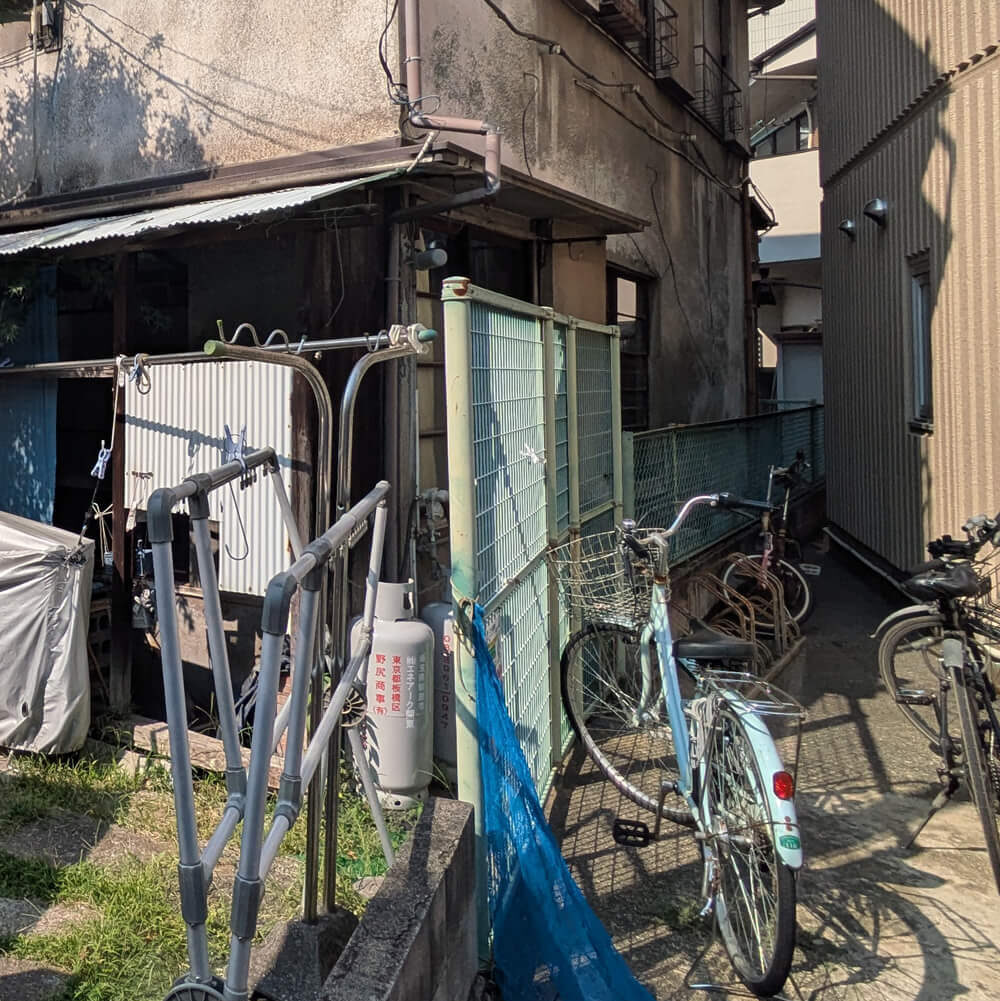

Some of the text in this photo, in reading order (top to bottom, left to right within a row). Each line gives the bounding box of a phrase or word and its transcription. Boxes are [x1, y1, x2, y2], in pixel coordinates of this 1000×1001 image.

[391, 655, 402, 712] 東京都板橋区
